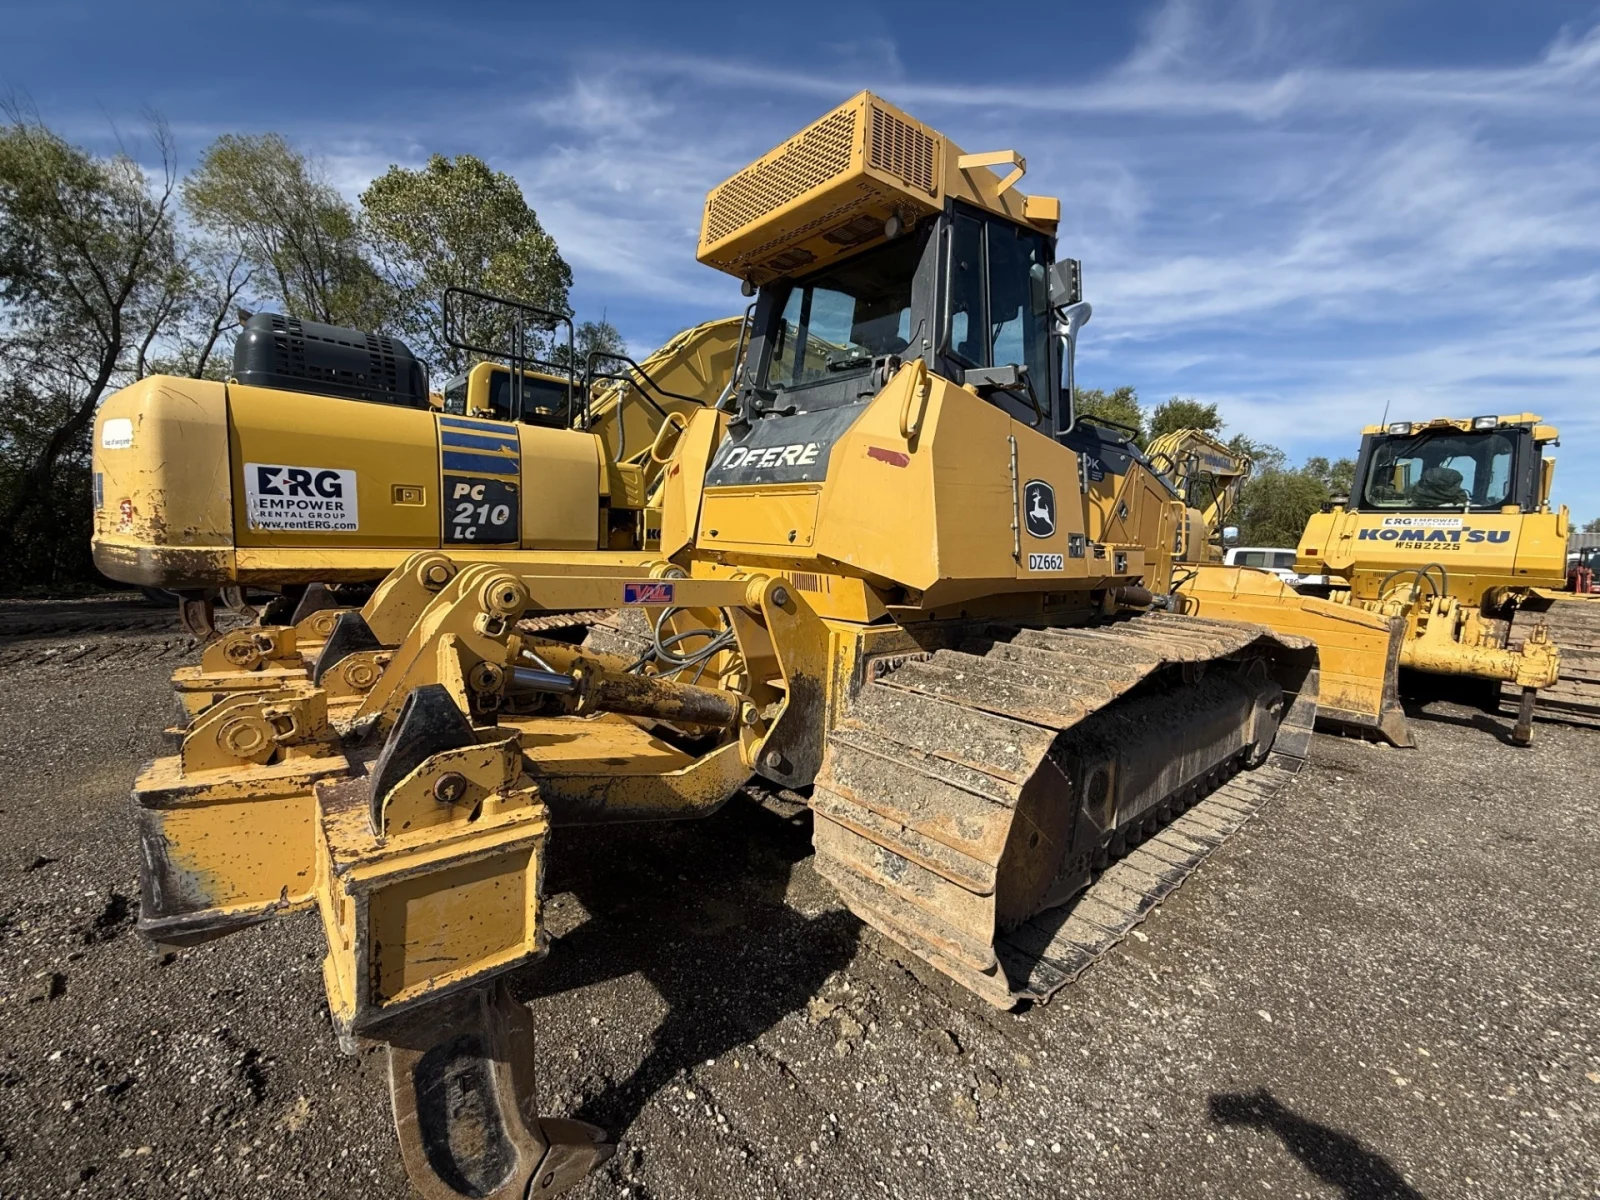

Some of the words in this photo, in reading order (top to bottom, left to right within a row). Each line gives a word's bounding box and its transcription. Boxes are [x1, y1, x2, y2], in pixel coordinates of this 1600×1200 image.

[257, 466, 342, 498] ERG
[452, 482, 486, 500] PC
[259, 498, 344, 511] EMPOWER
[259, 510, 304, 518] RENTAL
[452, 502, 510, 525] 210
[1384, 517, 1412, 525] ERG
[453, 526, 477, 540] LC
[1357, 527, 1511, 544] KOMATSU
[1029, 554, 1063, 570] DZ662
